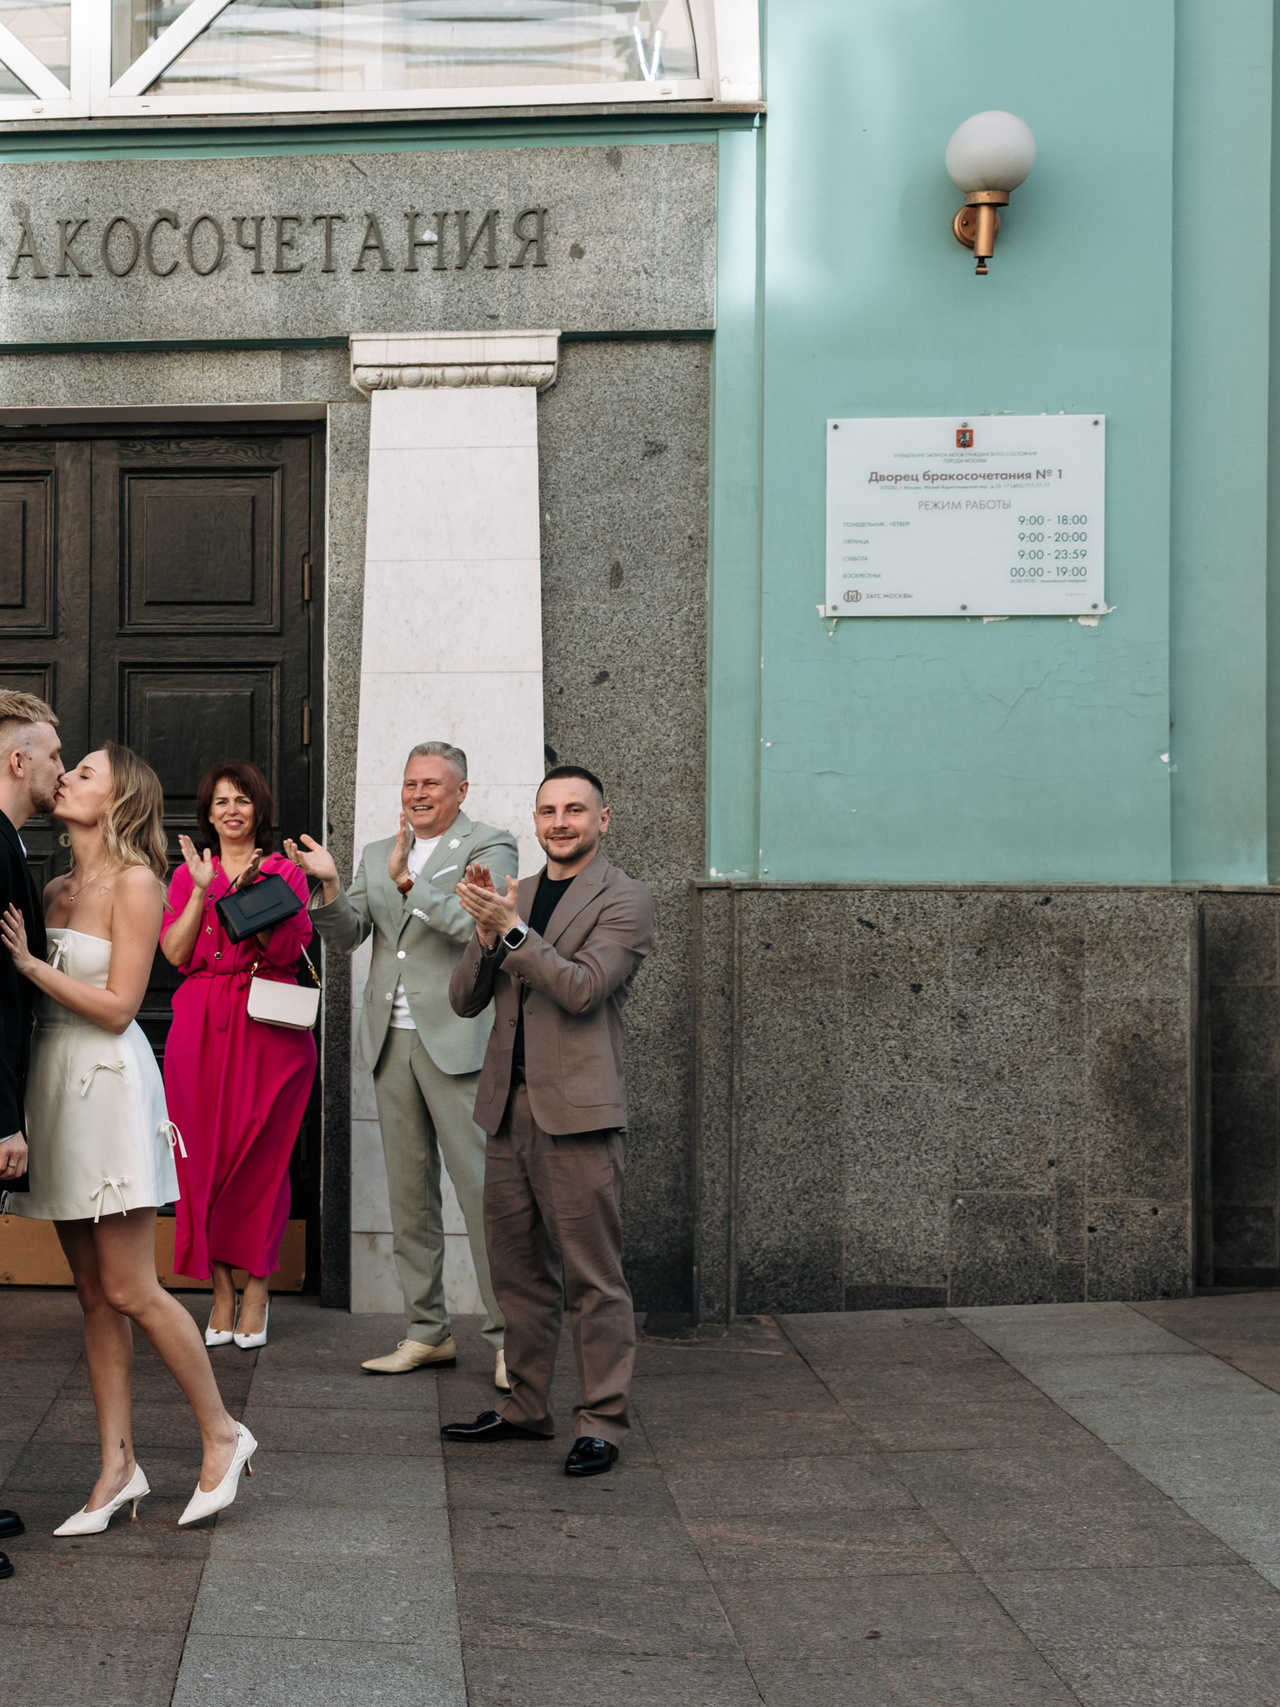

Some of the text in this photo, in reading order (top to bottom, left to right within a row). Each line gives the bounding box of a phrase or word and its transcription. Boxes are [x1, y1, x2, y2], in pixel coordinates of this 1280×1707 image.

[869, 471, 919, 484] Дворец
[923, 470, 1032, 482] бракосочетания
[1058, 468, 1063, 479] 1
[918, 500, 1012, 511] РЕЖИМ РАБОТЫ
[1018, 515, 1045, 526] 9:00
[1056, 514, 1088, 525] 18:00
[1018, 532, 1045, 543] 9:00
[1054, 531, 1088, 542] 20:00
[1018, 549, 1044, 560] 9:00
[1054, 549, 1087, 560] 23:59
[1010, 567, 1044, 577] 00:00
[1056, 566, 1087, 577] 19:00
